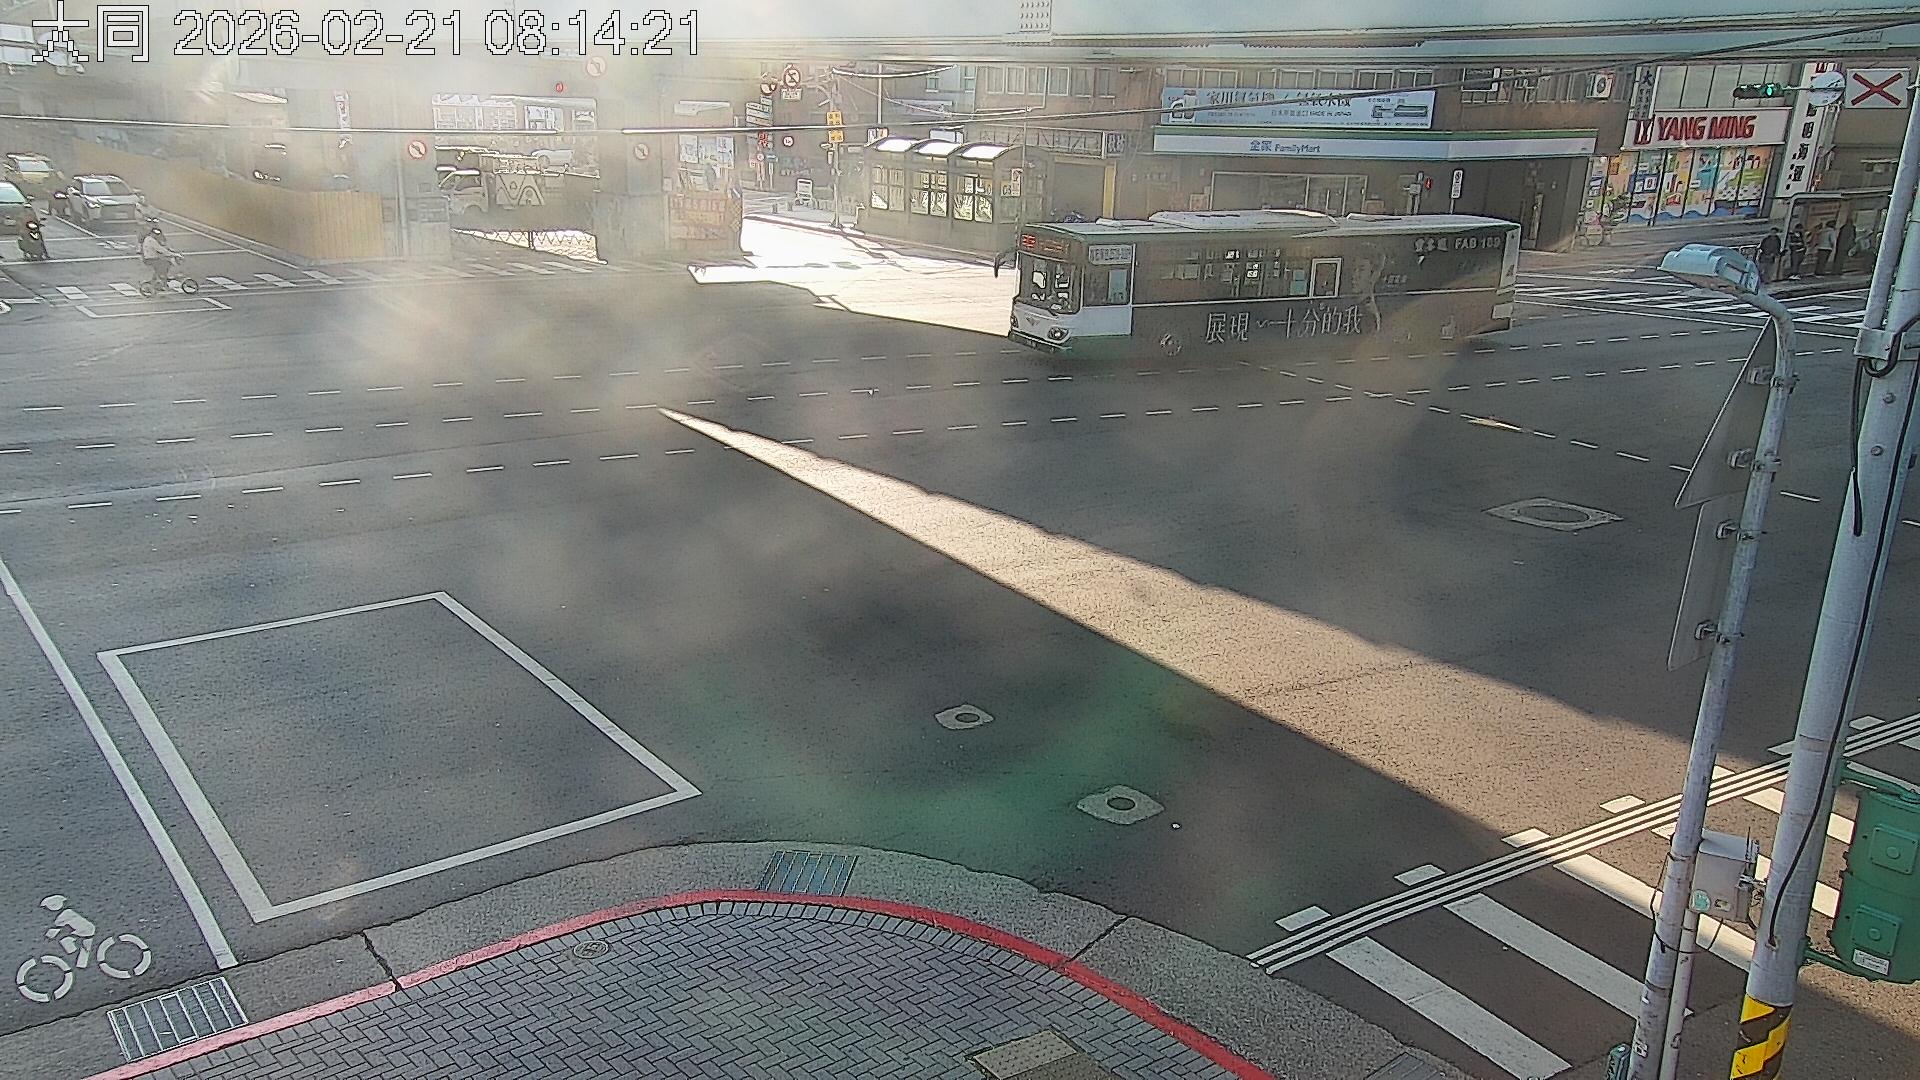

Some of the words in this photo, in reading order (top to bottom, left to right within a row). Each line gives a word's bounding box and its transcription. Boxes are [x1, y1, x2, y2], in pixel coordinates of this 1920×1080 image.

[1658, 115, 1707, 140] YANG
[1707, 114, 1757, 139] MING
[1274, 143, 1321, 154] FamilyMart
